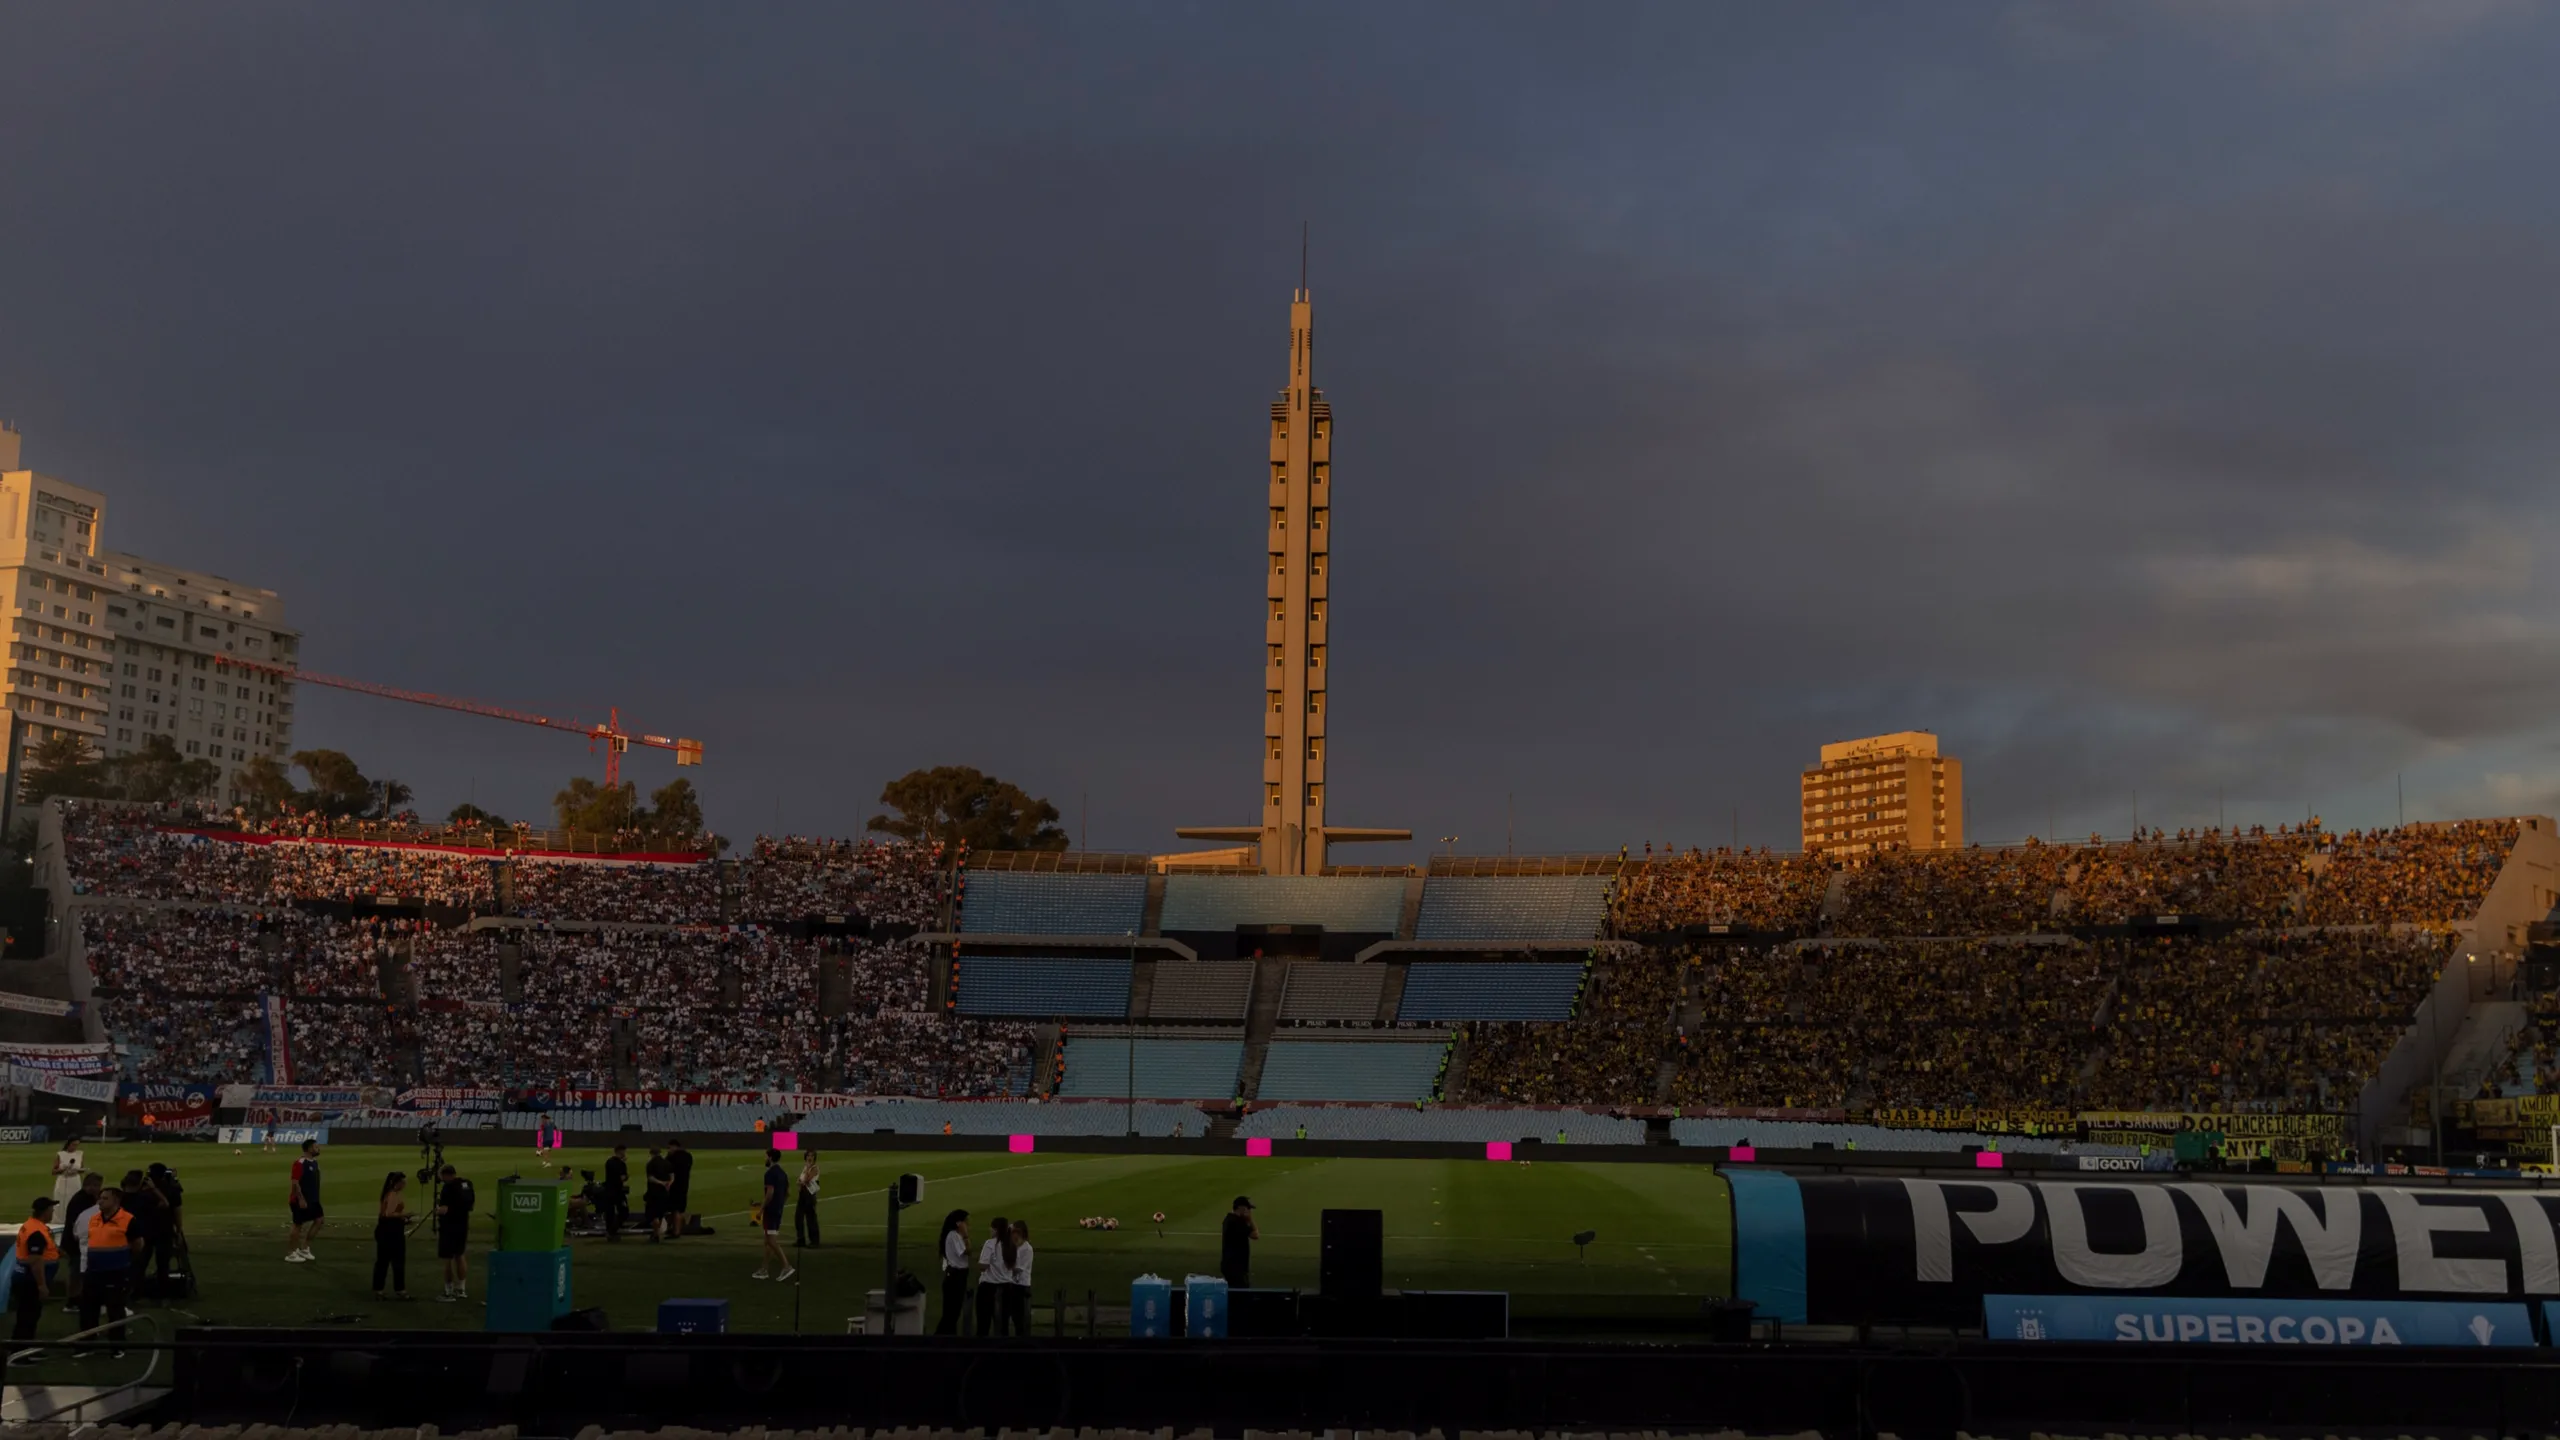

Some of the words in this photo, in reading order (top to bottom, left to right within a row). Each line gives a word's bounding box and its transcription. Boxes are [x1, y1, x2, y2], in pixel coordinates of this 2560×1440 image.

[144, 1084, 185, 1099] AMOR
[252, 1092, 316, 1102] JACINTO
[320, 1092, 360, 1102] VERA
[415, 1088, 443, 1098] DESDE
[445, 1089, 462, 1099] QUE
[463, 1089, 475, 1098] TE
[556, 1092, 583, 1107] LOS
[595, 1093, 653, 1109] BOLSOS
[669, 1094, 687, 1107] DE
[791, 1096, 856, 1111] TREINTA
[2086, 1114, 2122, 1129] VILLA
[1, 1129, 30, 1141] GOLTV
[260, 1130, 320, 1143] Tnfield
[2100, 1159, 2141, 1170] GOLTV
[515, 1196, 538, 1207] VAR
[2114, 1313, 2401, 1346] SUPERCOPA
